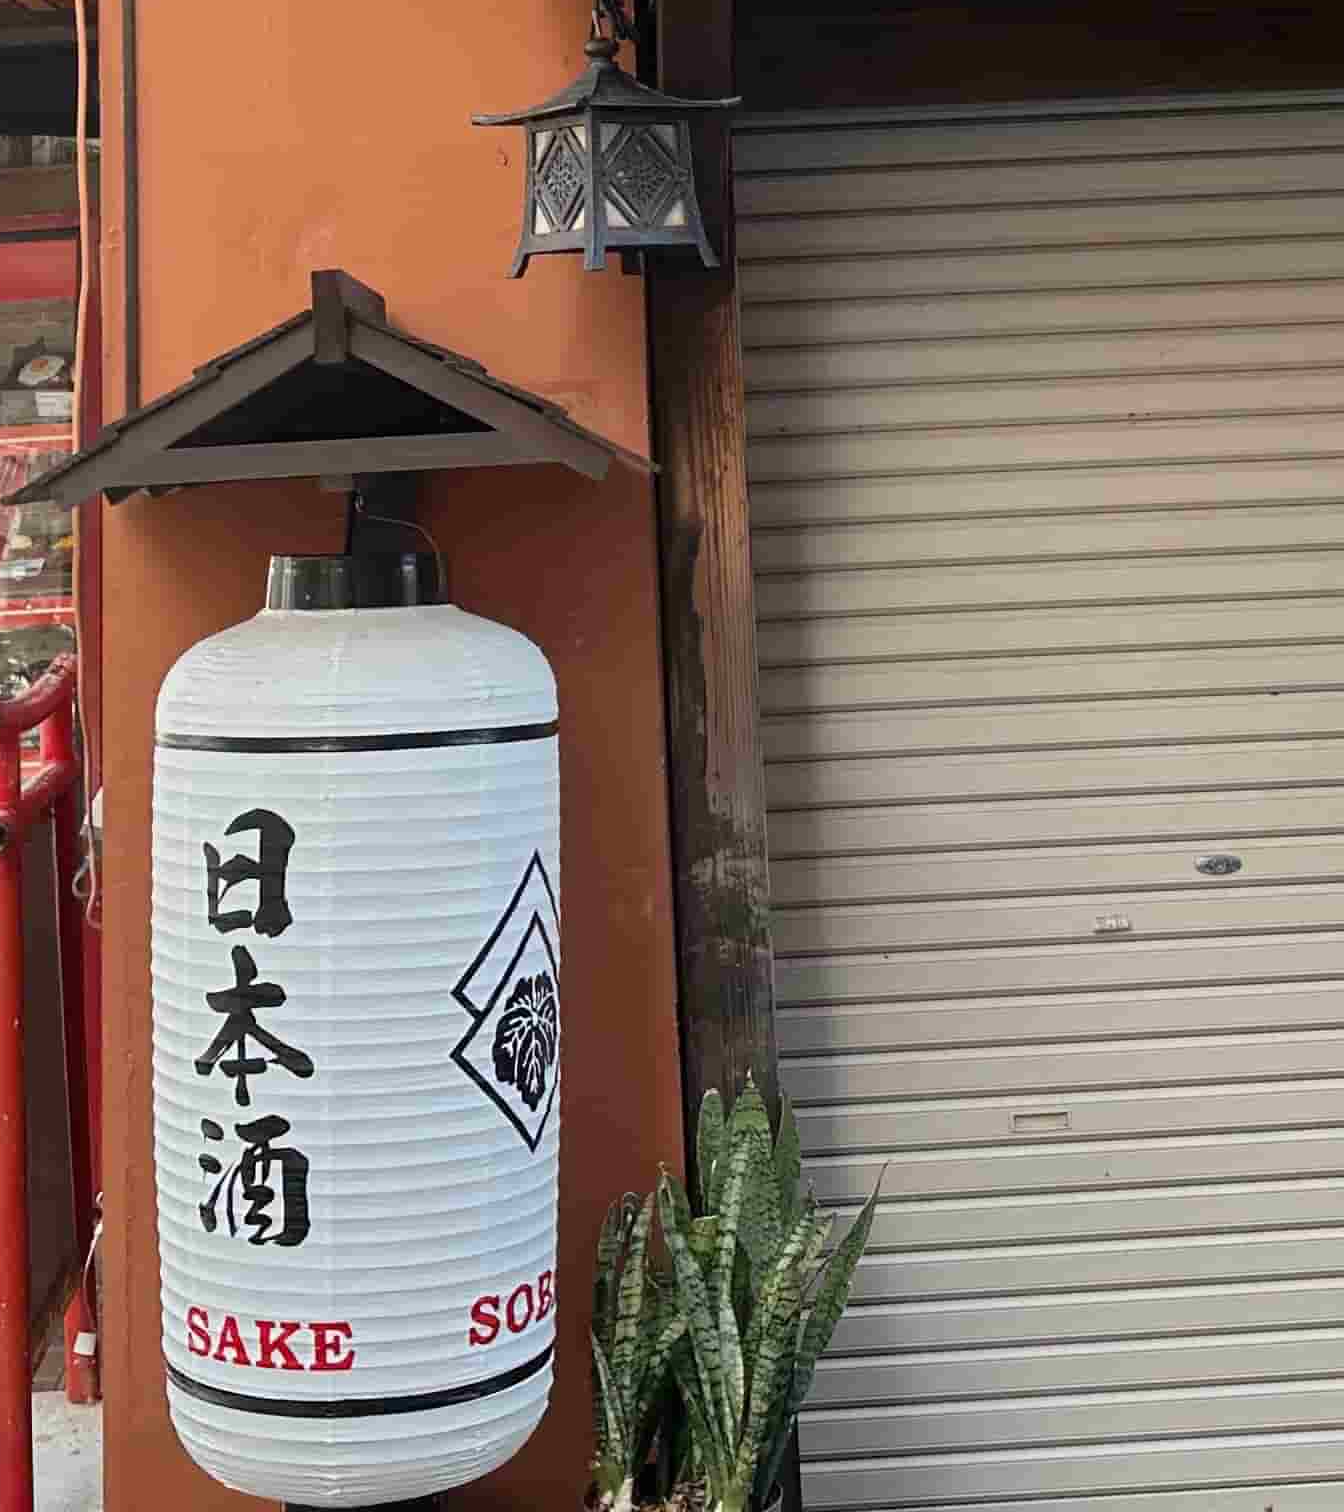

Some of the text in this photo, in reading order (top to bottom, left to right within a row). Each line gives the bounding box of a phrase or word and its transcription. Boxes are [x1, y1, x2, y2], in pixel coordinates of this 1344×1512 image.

[192, 806, 316, 1250] 日本酒
[185, 1303, 356, 1372] SAKE
